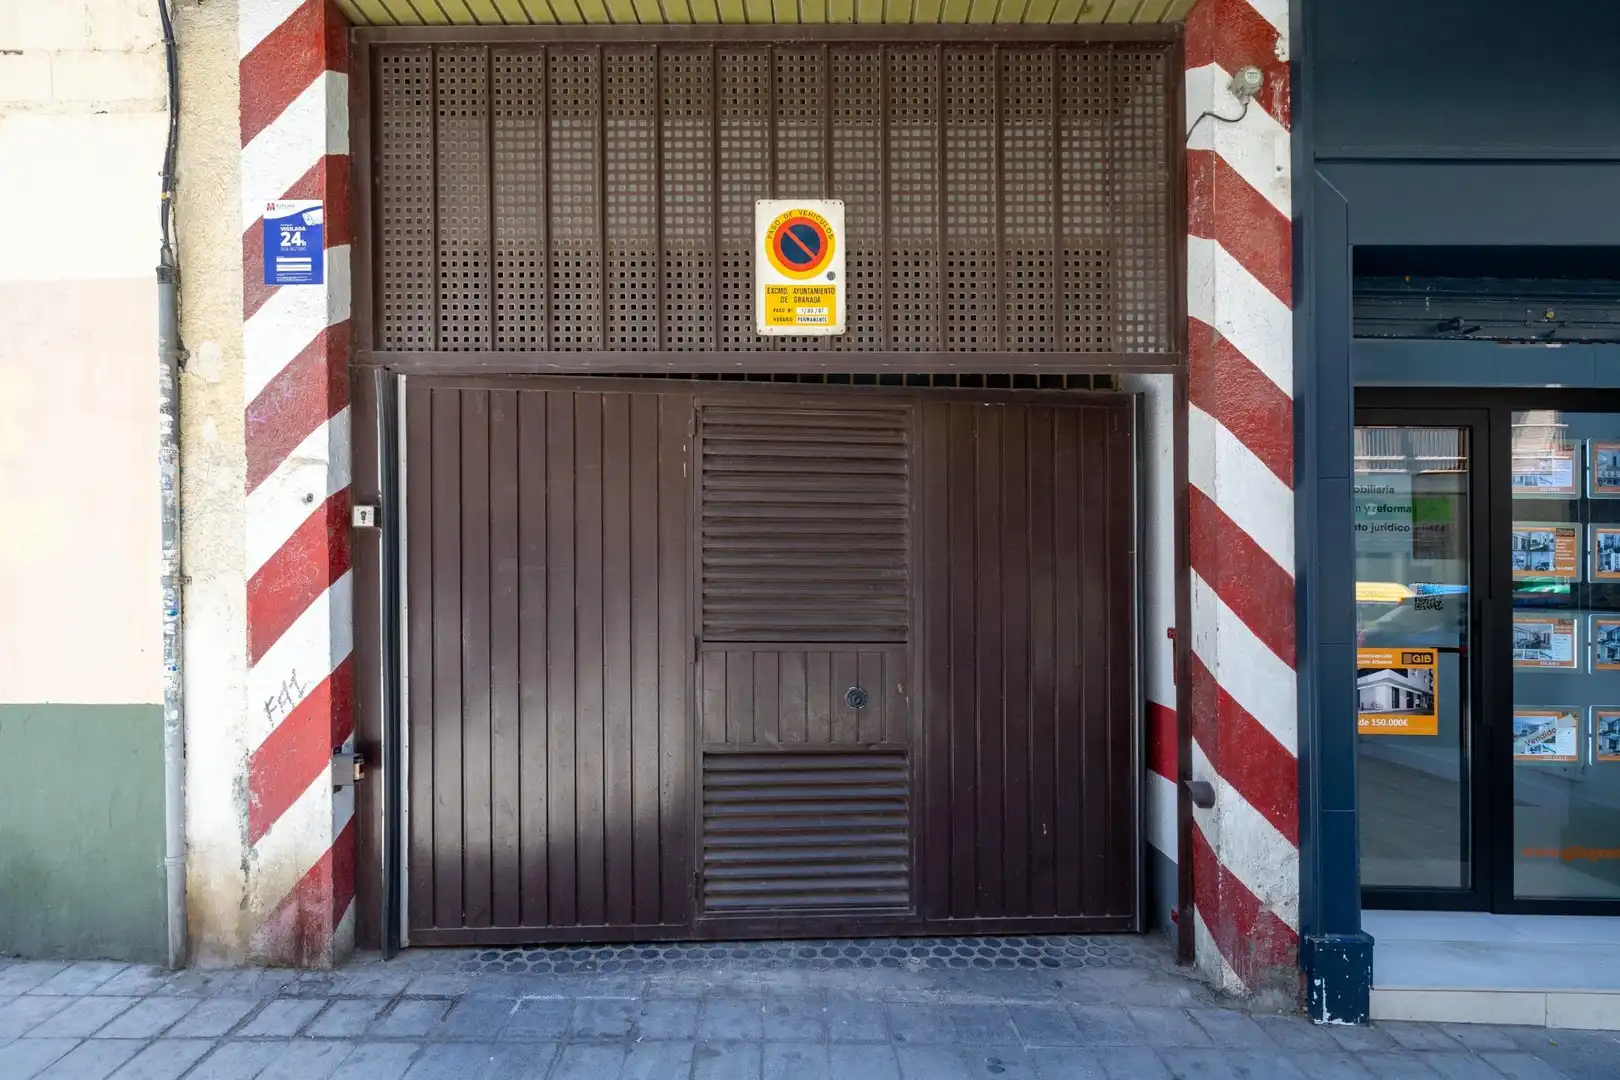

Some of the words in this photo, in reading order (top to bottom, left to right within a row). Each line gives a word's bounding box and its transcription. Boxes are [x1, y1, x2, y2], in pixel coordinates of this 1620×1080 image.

[767, 219, 781, 240] PASO
[783, 211, 793, 220] DE
[798, 210, 834, 240] VEHICULOS
[793, 287, 836, 295] AYUNTAMIENTO
[793, 296, 821, 304] GRANADA
[1372, 503, 1411, 513] reforma
[1371, 522, 1410, 533] jurídico
[1412, 654, 1432, 663] GIB
[1524, 727, 1556, 746] Vendido
